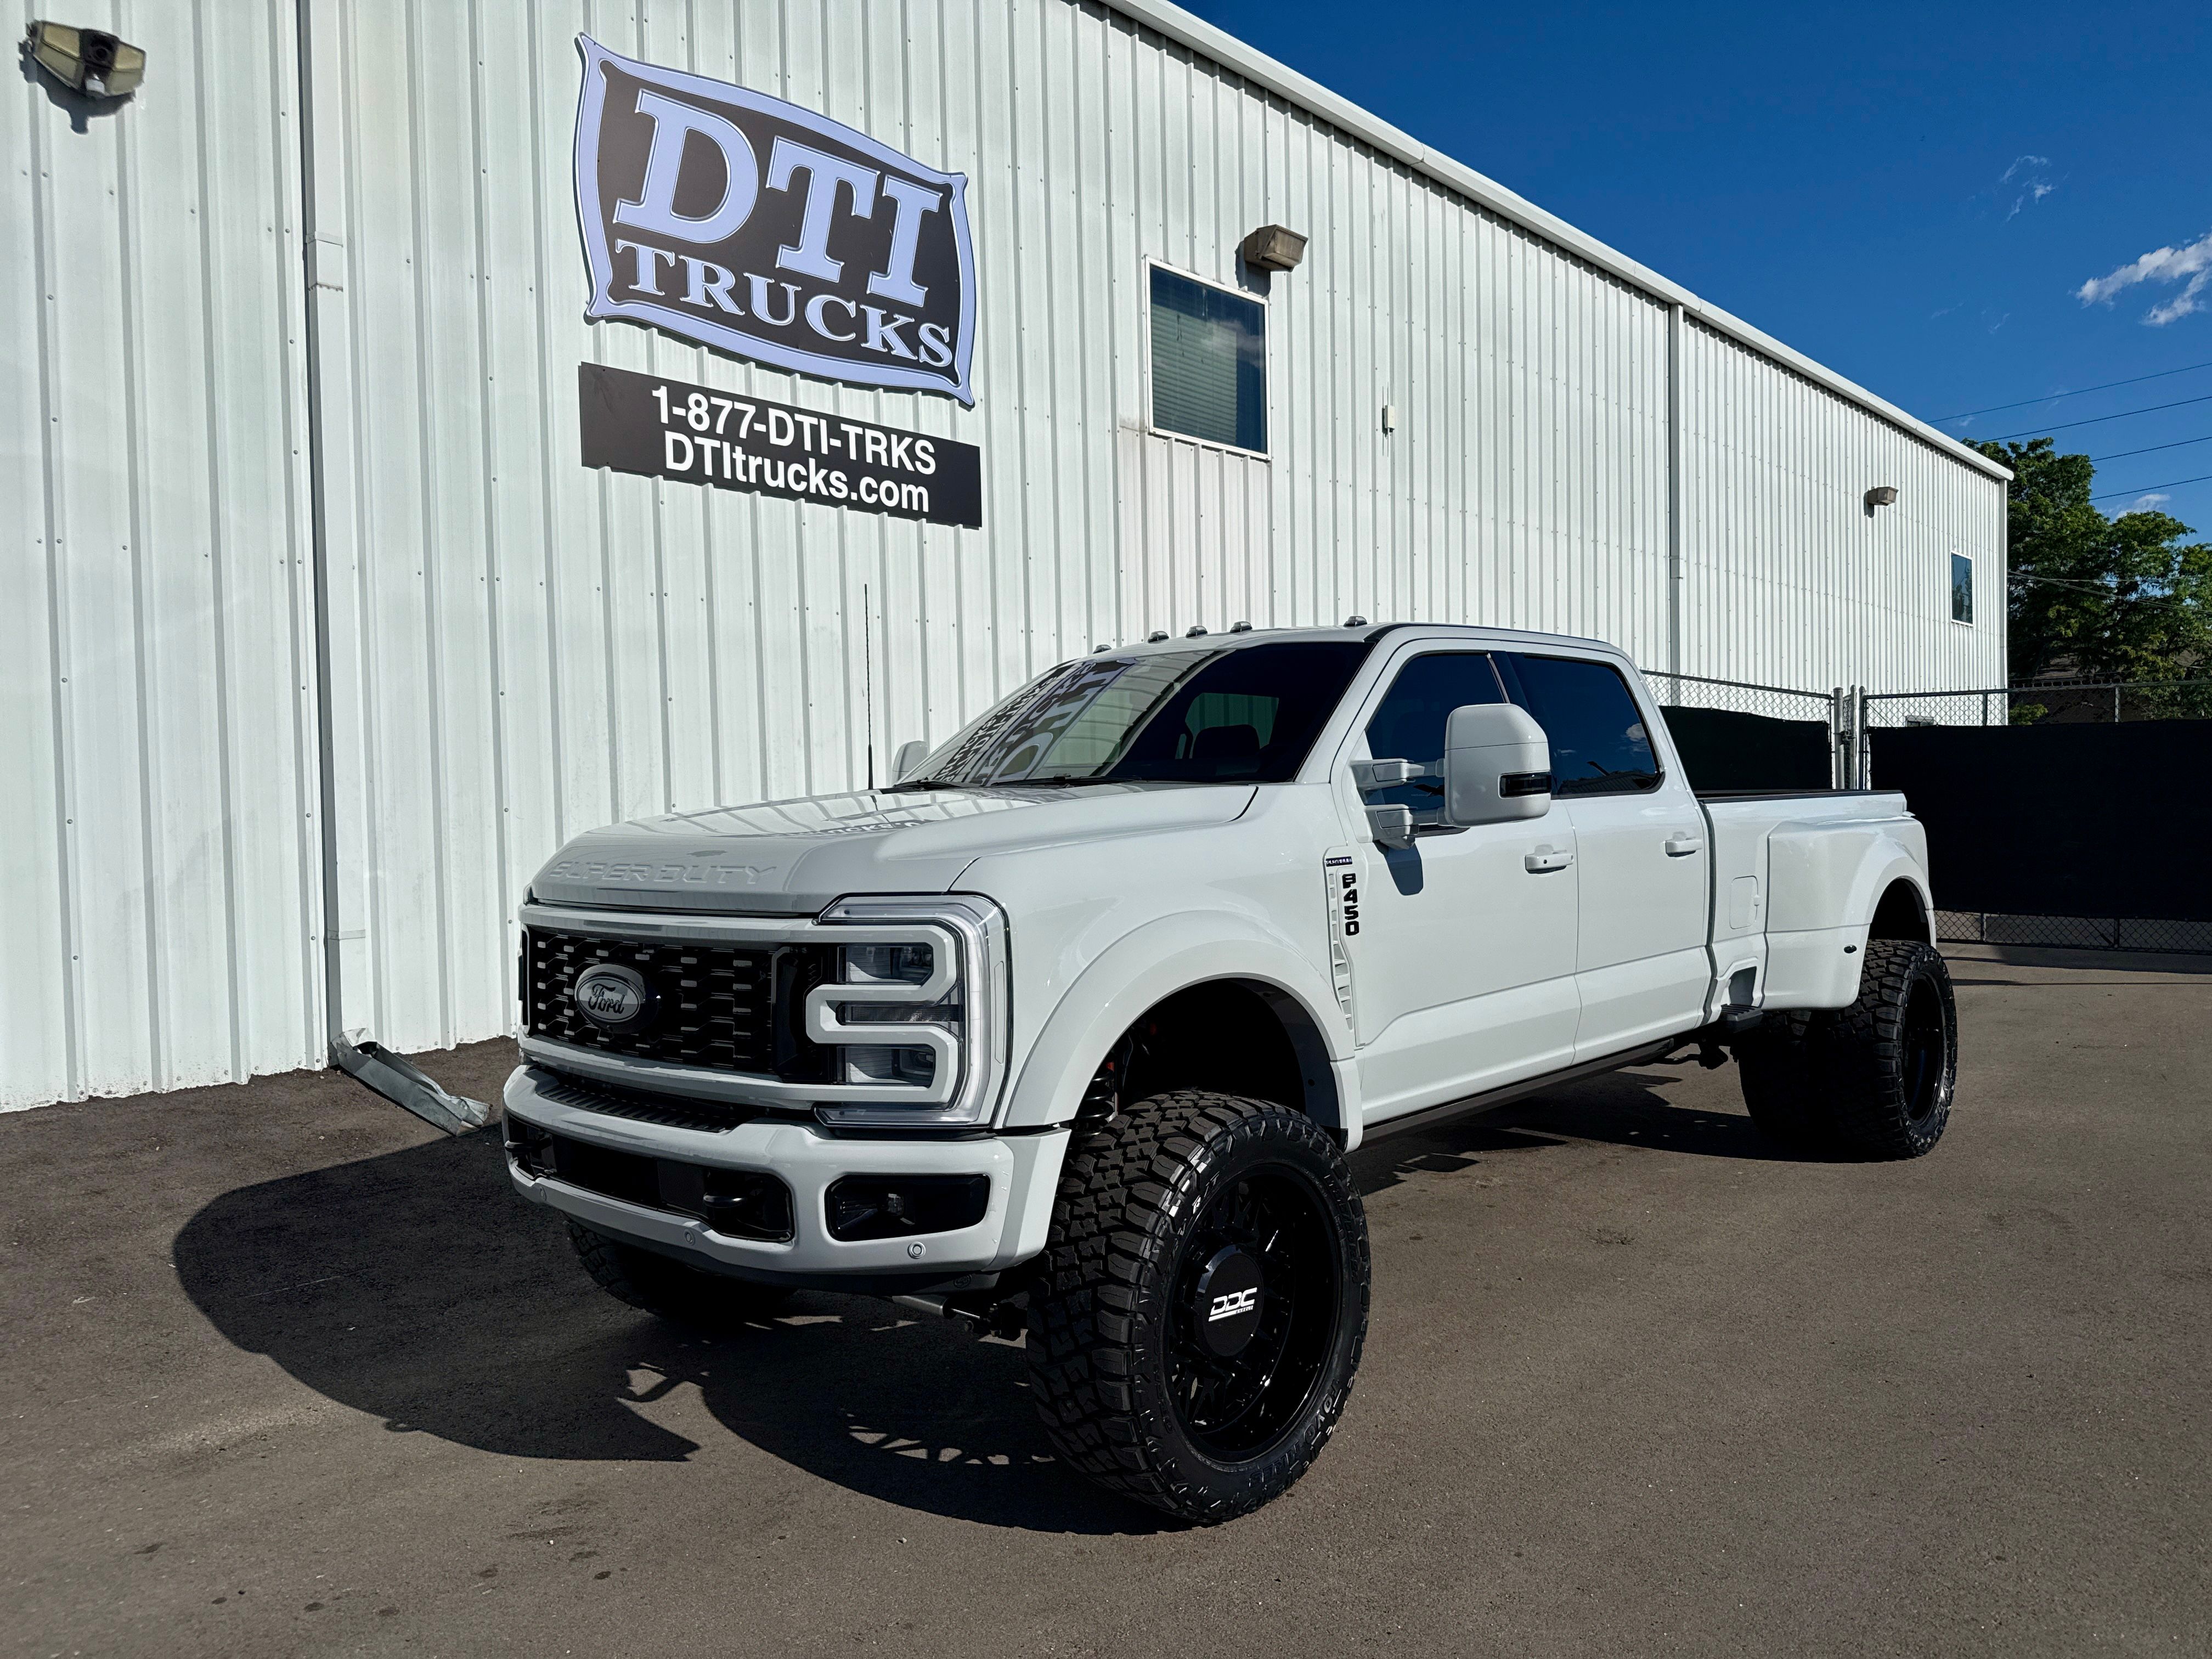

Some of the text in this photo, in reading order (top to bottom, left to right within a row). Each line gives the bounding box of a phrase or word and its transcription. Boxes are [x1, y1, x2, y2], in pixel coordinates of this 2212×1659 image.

[613, 89, 943, 307] DTI
[614, 238, 953, 368] TRUCKS
[652, 386, 936, 476] 1-877-DTI-TRKS
[664, 430, 929, 512] DTItrucks.com
[550, 861, 777, 884] SUPER DUTY
[588, 983, 624, 1014] Ford
[1210, 1287, 1257, 1316] DDC
